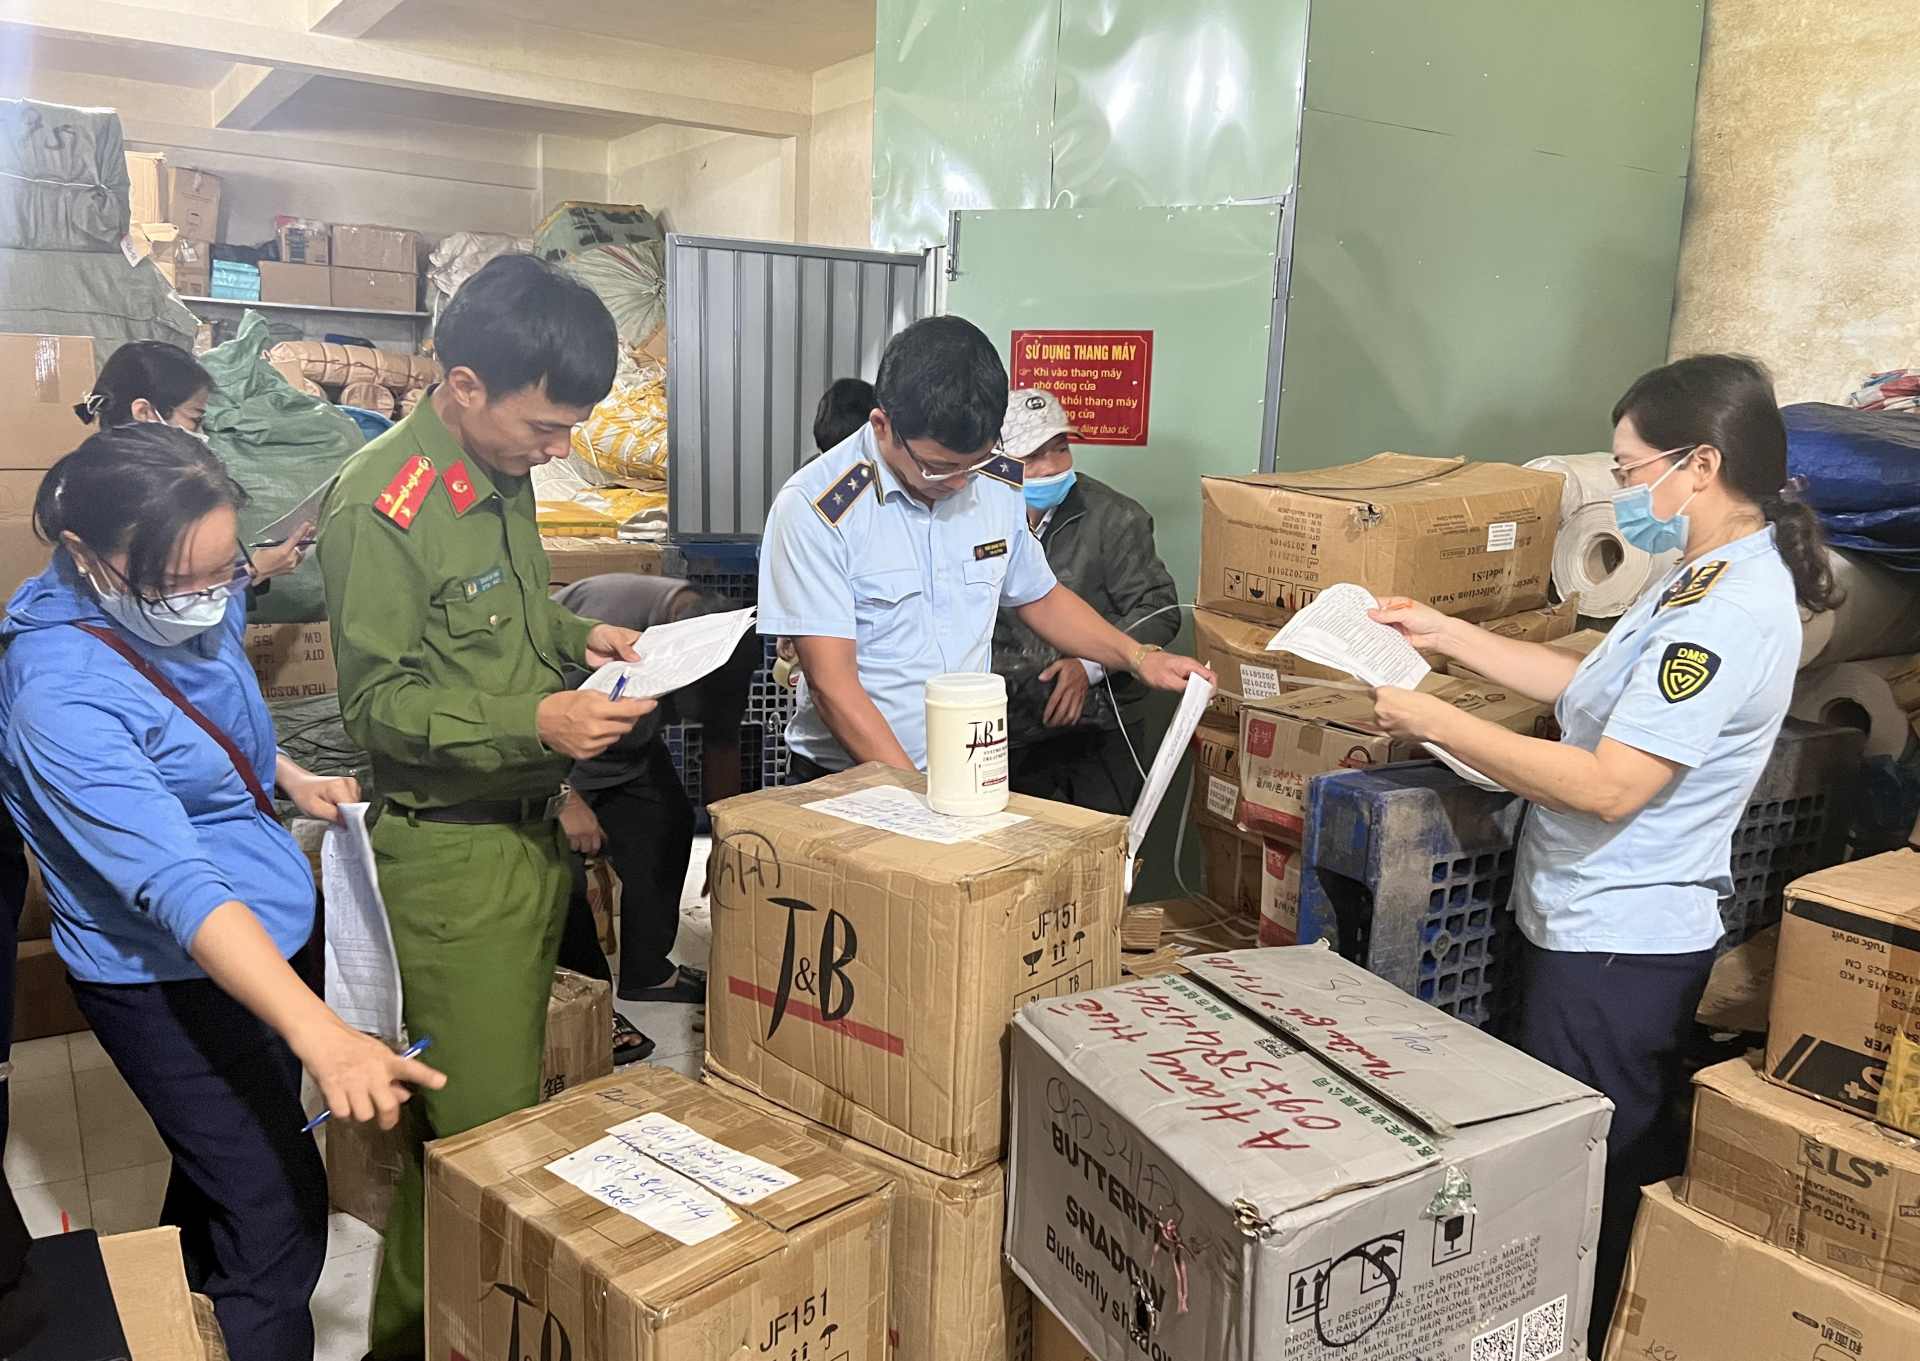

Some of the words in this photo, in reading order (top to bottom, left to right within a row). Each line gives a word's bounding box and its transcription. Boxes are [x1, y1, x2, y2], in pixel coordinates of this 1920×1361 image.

[1025, 339, 1041, 359] SỬ
[1042, 344, 1070, 363] DỤNG
[1073, 344, 1108, 360] THANG
[1112, 342, 1136, 360] MÁY
[1033, 380, 1052, 390] nhớ
[1053, 381, 1077, 392] đóng
[1079, 380, 1096, 391] cửa
[1034, 367, 1048, 377] Khi
[1051, 367, 1068, 377] vào
[1071, 367, 1098, 379] thang
[1101, 368, 1122, 379] máy
[1061, 395, 1082, 406] khỏi
[1085, 396, 1113, 408] thang
[1116, 397, 1138, 408] máy
[1078, 408, 1095, 419] cửa
[1472, 568, 1512, 582] odel:S1
[1430, 593, 1455, 605] Swab
[1458, 584, 1502, 599] Collection
[1677, 648, 1709, 664] DMS
[302, 683, 326, 695] ITEM
[1032, 899, 1077, 941] JF151
[1839, 970, 1854, 982] KG
[1845, 958, 1861, 970] CM
[543, 1074, 565, 1101] 箱
[1796, 1174, 1856, 1203] HAVY-DUTY
[1795, 1184, 1844, 1210] AUMINUM
[1845, 1205, 1871, 1221] LEVEL
[1047, 1224, 1109, 1314] Butterfly
[1338, 1288, 1406, 1323] DESCRIPTN:
[1412, 1278, 1434, 1294] THIS
[1439, 1258, 1485, 1285] PRODUCT
[1489, 1254, 1497, 1265] IS
[1502, 1242, 1525, 1259] MADE
[1529, 1235, 1540, 1247] OF
[1284, 1328, 1333, 1357] IMPORD
[1336, 1318, 1357, 1335] RAW
[1416, 1292, 1425, 1303] IT
[1426, 1284, 1445, 1300] CAN
[1447, 1278, 1462, 1292] FIX
[1464, 1271, 1482, 1286] THE
[1484, 1262, 1503, 1277] HAIR
[1353, 1334, 1370, 1349] THE
[1375, 1294, 1473, 1340] THREE-DIMENSIONAL
[1478, 1274, 1523, 1301] PLASTICITY
[1527, 1266, 1537, 1277] OF
[1402, 1308, 1410, 1318] IT
[1413, 1300, 1432, 1315] CAN
[1435, 1293, 1450, 1306] FIX
[1452, 1286, 1470, 1300] THE
[1472, 1277, 1493, 1292] HAIR
[759, 1287, 828, 1353] JF151
[1363, 1337, 1389, 1355] MAKE
[1395, 1328, 1413, 1342] THE
[1419, 1317, 1441, 1333] HAIR
[1446, 1304, 1474, 1323] MORE
[1480, 1286, 1516, 1310] NATURAL
[1520, 1275, 1536, 1291] AND
[1411, 1332, 1430, 1346] ARE
[1491, 1300, 1508, 1315] CAN
[1510, 1286, 1535, 1306] SHAPE
[1821, 1324, 1863, 1356] 和面机
